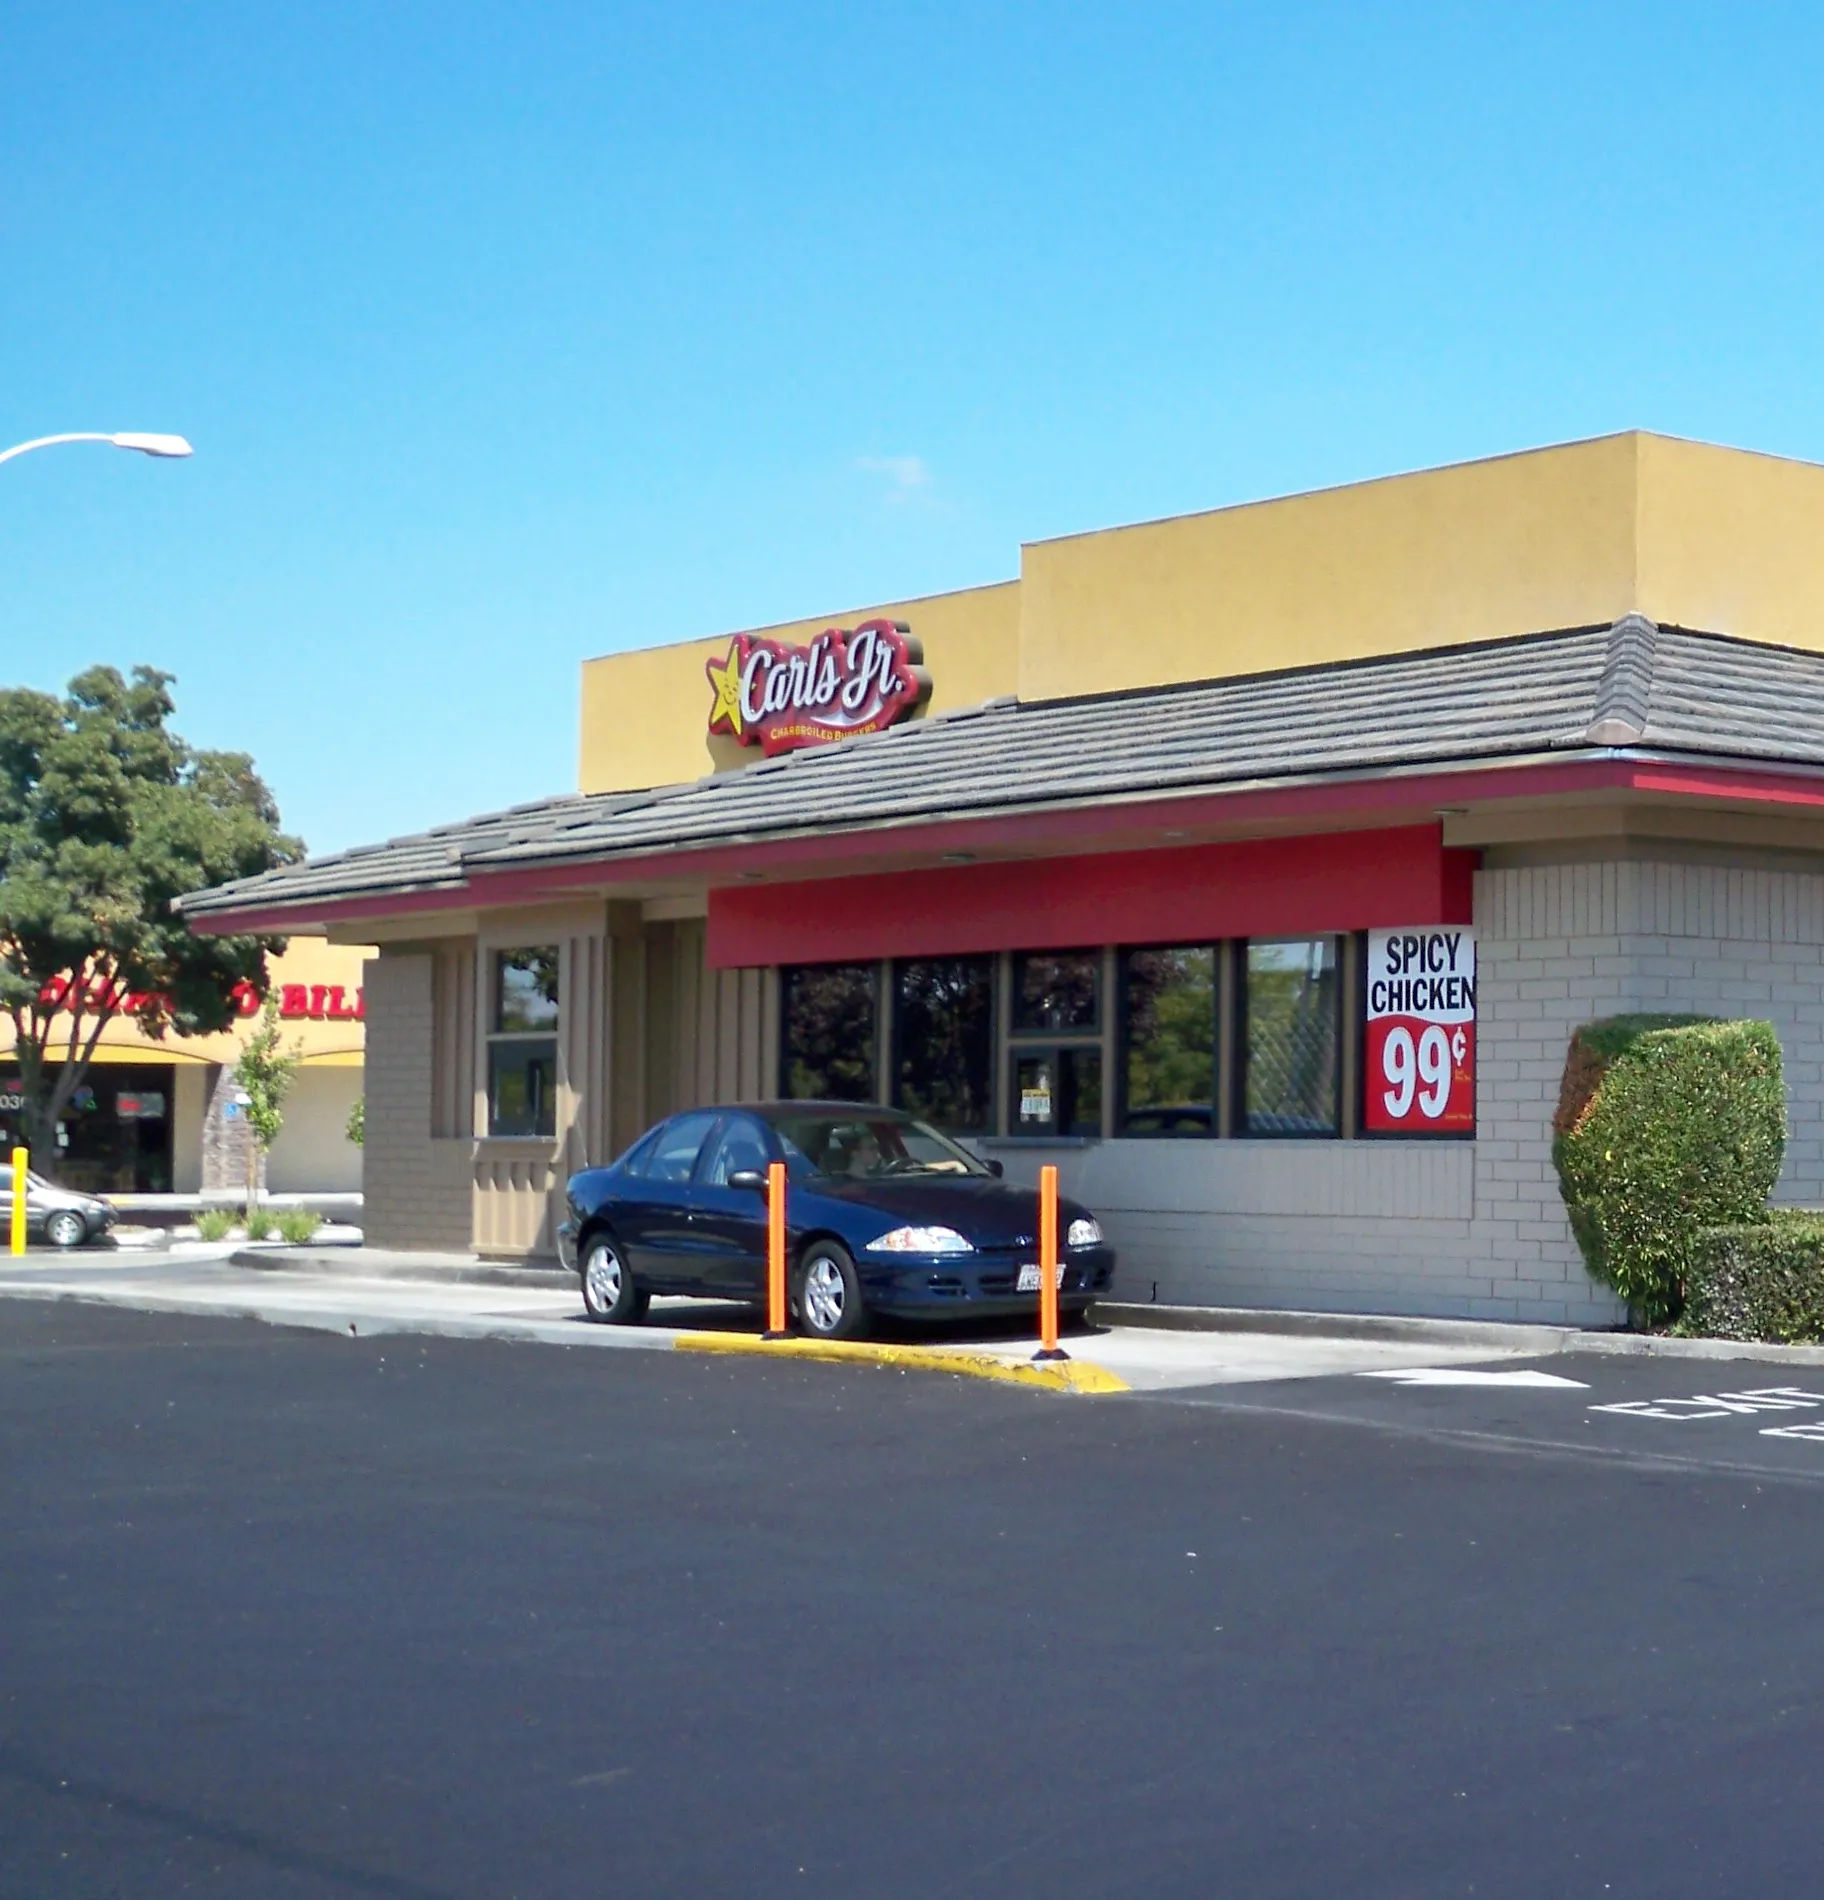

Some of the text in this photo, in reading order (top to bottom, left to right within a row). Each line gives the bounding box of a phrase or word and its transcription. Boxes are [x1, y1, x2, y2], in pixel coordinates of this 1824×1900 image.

[740, 629, 903, 724] Carl's Jr.
[770, 725, 833, 740] CHARBROILED
[1386, 933, 1461, 975] SPICY
[1371, 976, 1475, 1013] CHICKEN
